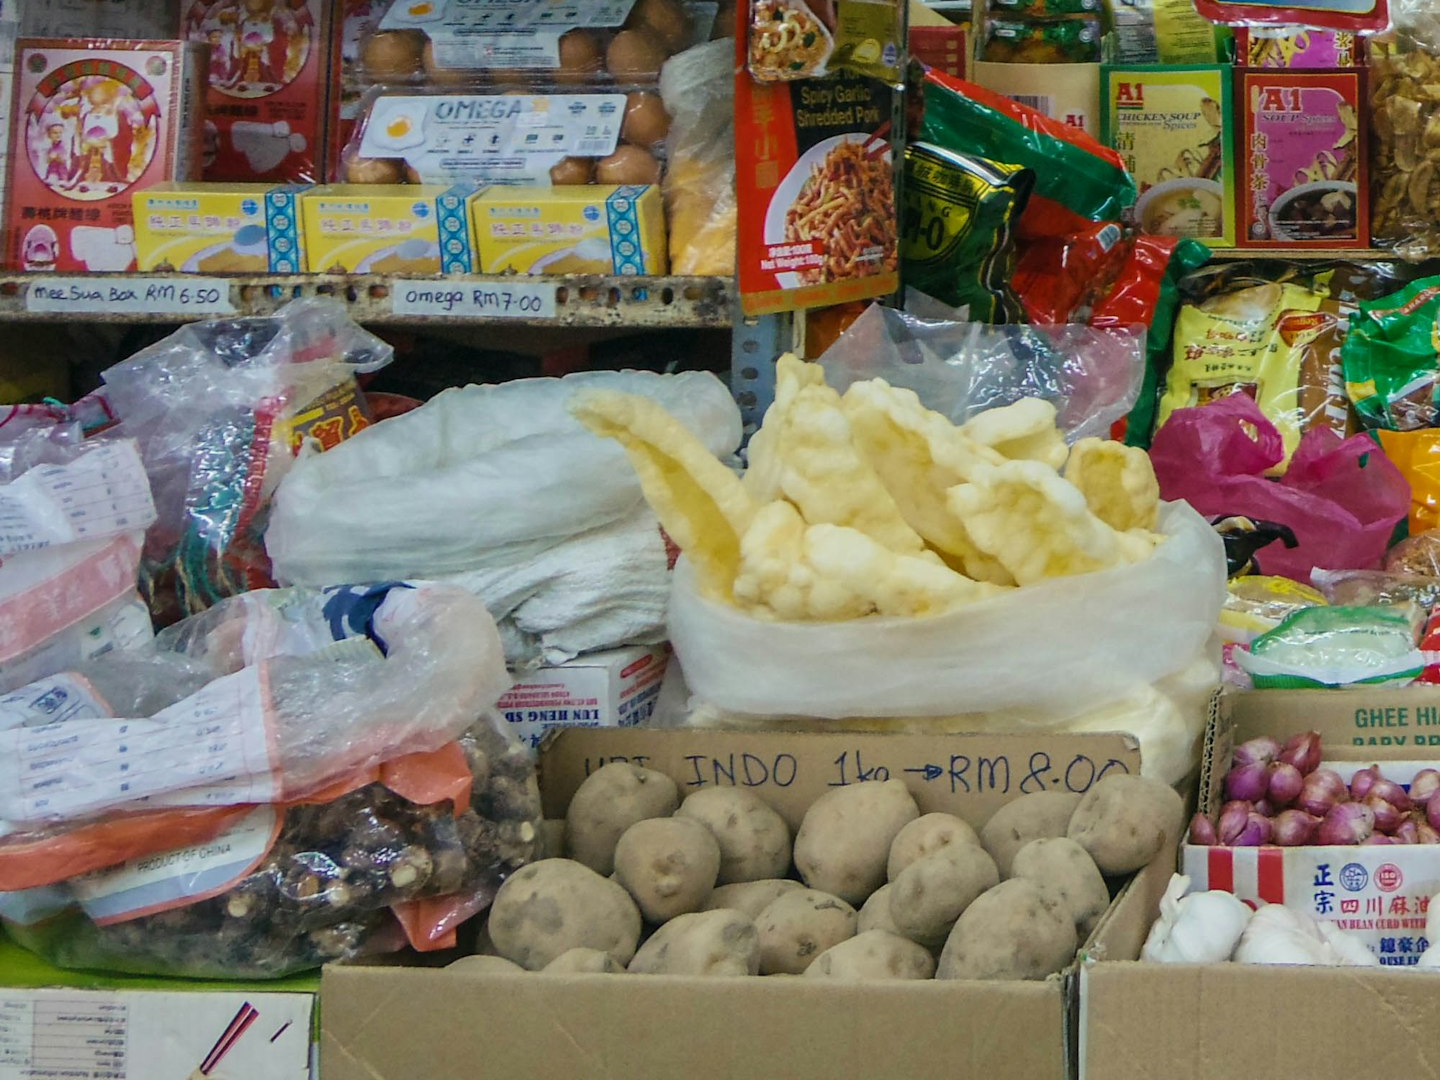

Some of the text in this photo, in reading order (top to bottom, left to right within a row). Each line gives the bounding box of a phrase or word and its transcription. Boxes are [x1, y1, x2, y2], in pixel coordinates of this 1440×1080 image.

[801, 84, 871, 106] Spicy Garlic
[1117, 83, 1143, 101] A1
[1263, 88, 1302, 112] A1
[435, 101, 522, 120] OMEGA
[797, 107, 880, 127] Shredded Pork
[1118, 112, 1201, 122] CHICKEN SOUP
[1262, 113, 1300, 122] SOUP
[1066, 114, 1084, 127] A1
[1163, 120, 1197, 130] Spices
[761, 259, 775, 270] Net
[145, 283, 175, 301] RM
[405, 289, 463, 310] omega
[527, 709, 568, 722] HENG
[573, 709, 600, 721] LUN
[1355, 707, 1409, 729] GHEE
[684, 753, 797, 788] INDO
[948, 754, 1011, 794] RM
[137, 843, 233, 874] PRODUCT OF CHINA
[1313, 863, 1336, 915] 正宗
[1340, 895, 1430, 916] 四川麻油
[1349, 918, 1375, 930] BEAN
[1376, 918, 1401, 930] CURD
